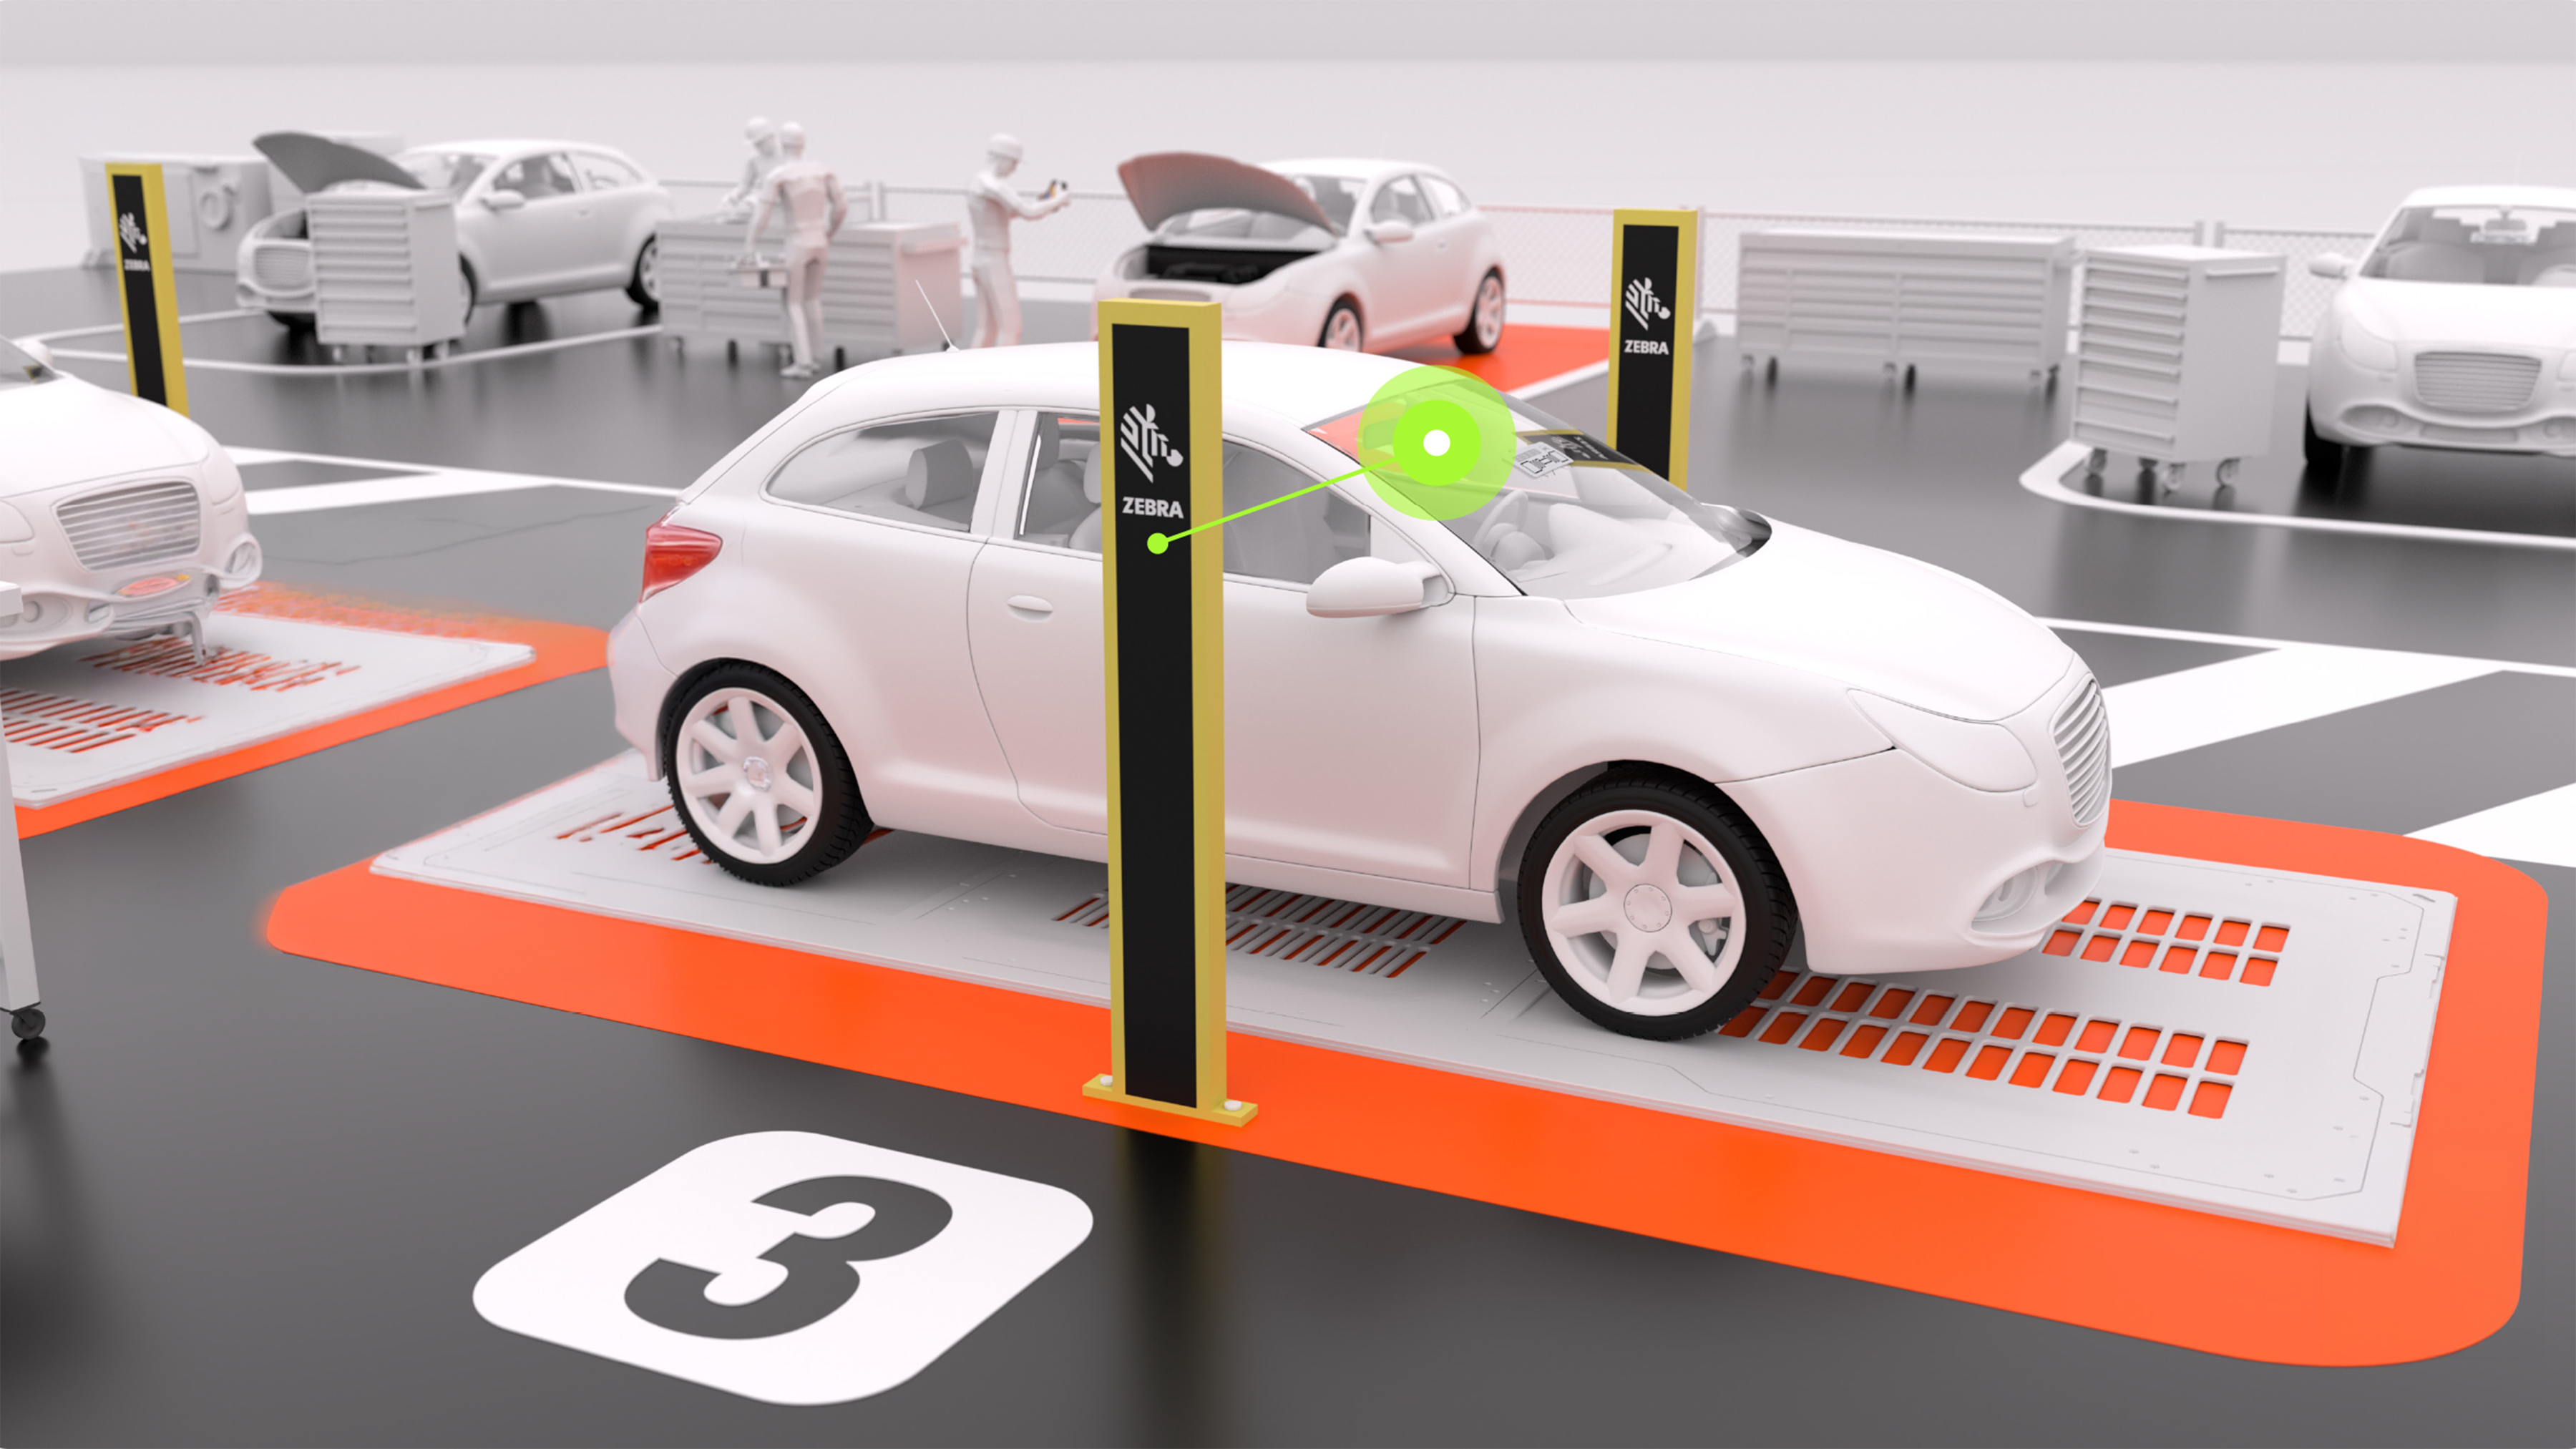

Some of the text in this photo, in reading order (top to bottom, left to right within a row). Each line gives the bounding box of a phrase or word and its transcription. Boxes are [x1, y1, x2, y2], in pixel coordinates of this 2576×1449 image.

[1624, 339, 1669, 355] ZEBRA
[1122, 496, 1184, 519] ZEBRA
[624, 1175, 954, 1340] 3
